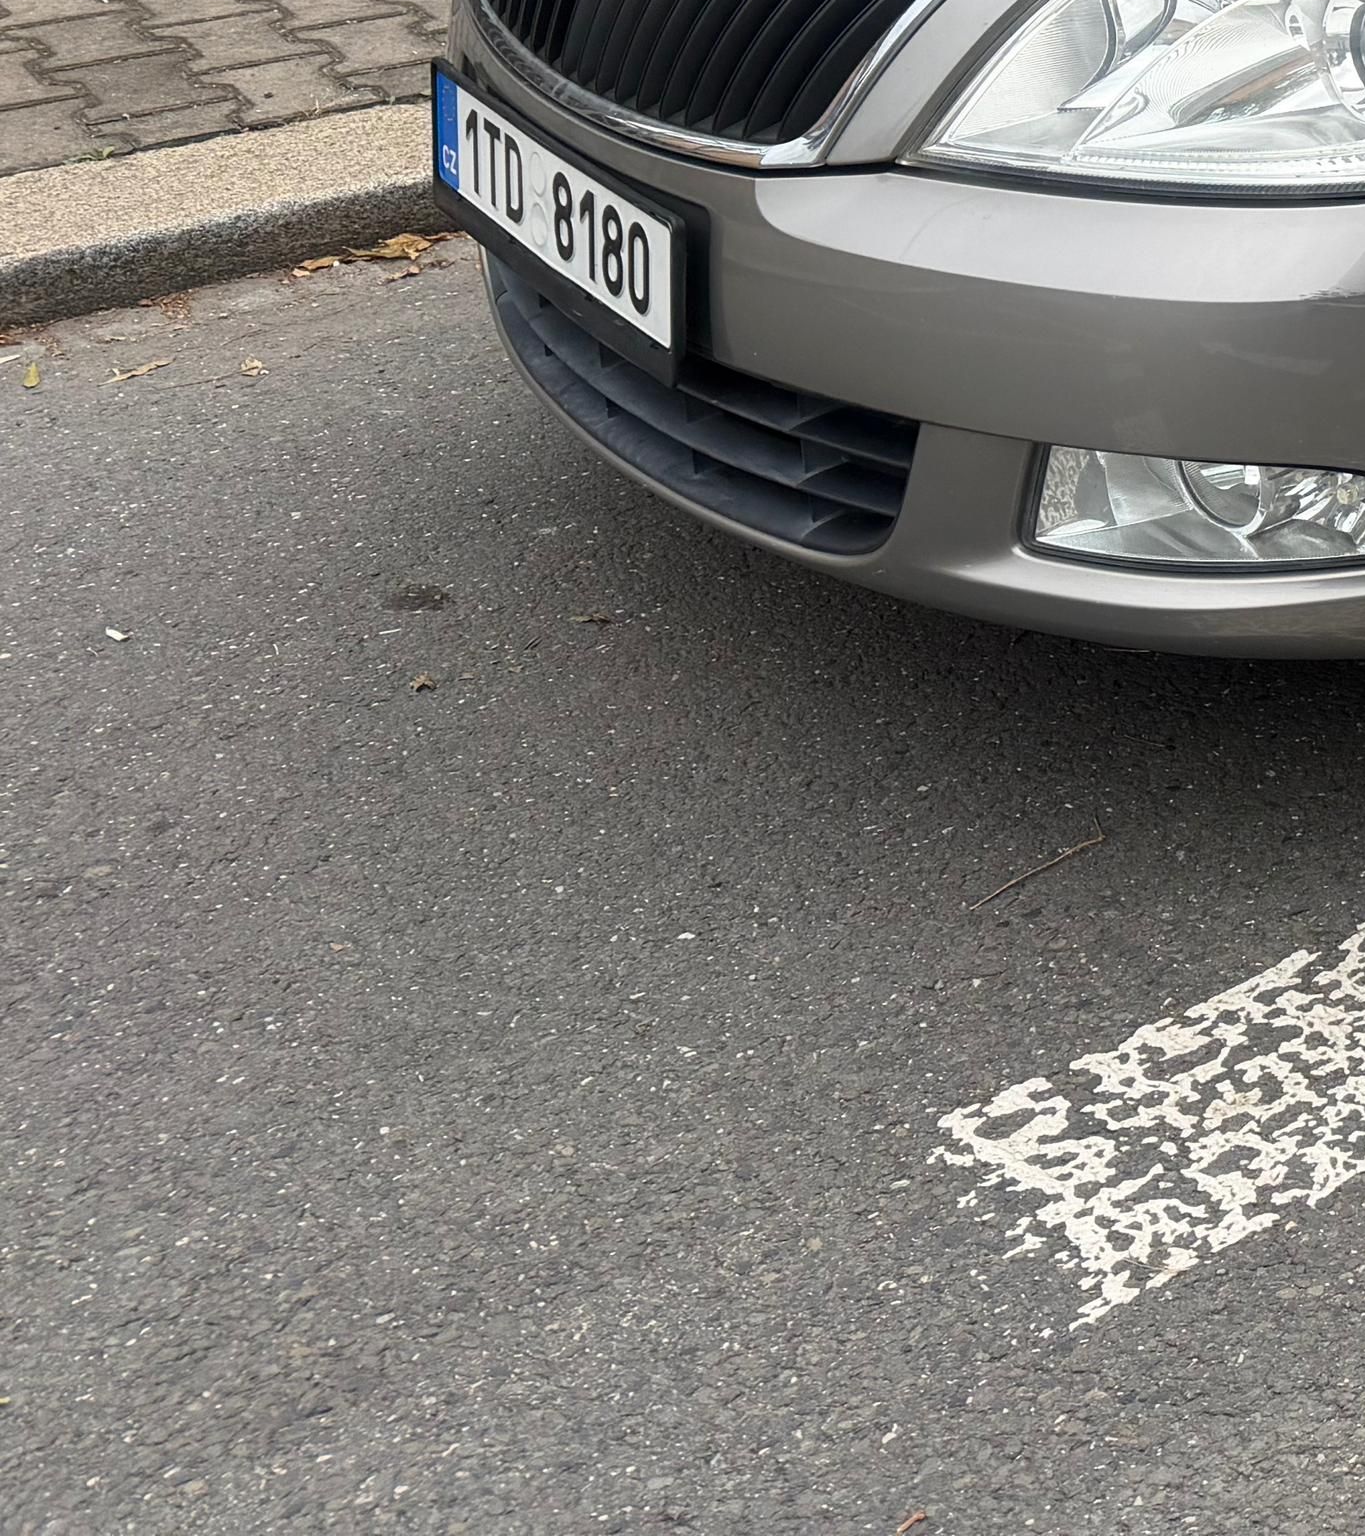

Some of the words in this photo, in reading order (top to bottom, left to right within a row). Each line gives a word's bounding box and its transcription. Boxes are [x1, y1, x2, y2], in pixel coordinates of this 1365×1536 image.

[442, 144, 458, 175] CZ
[466, 108, 524, 224] 1TD
[552, 171, 650, 316] 8180
